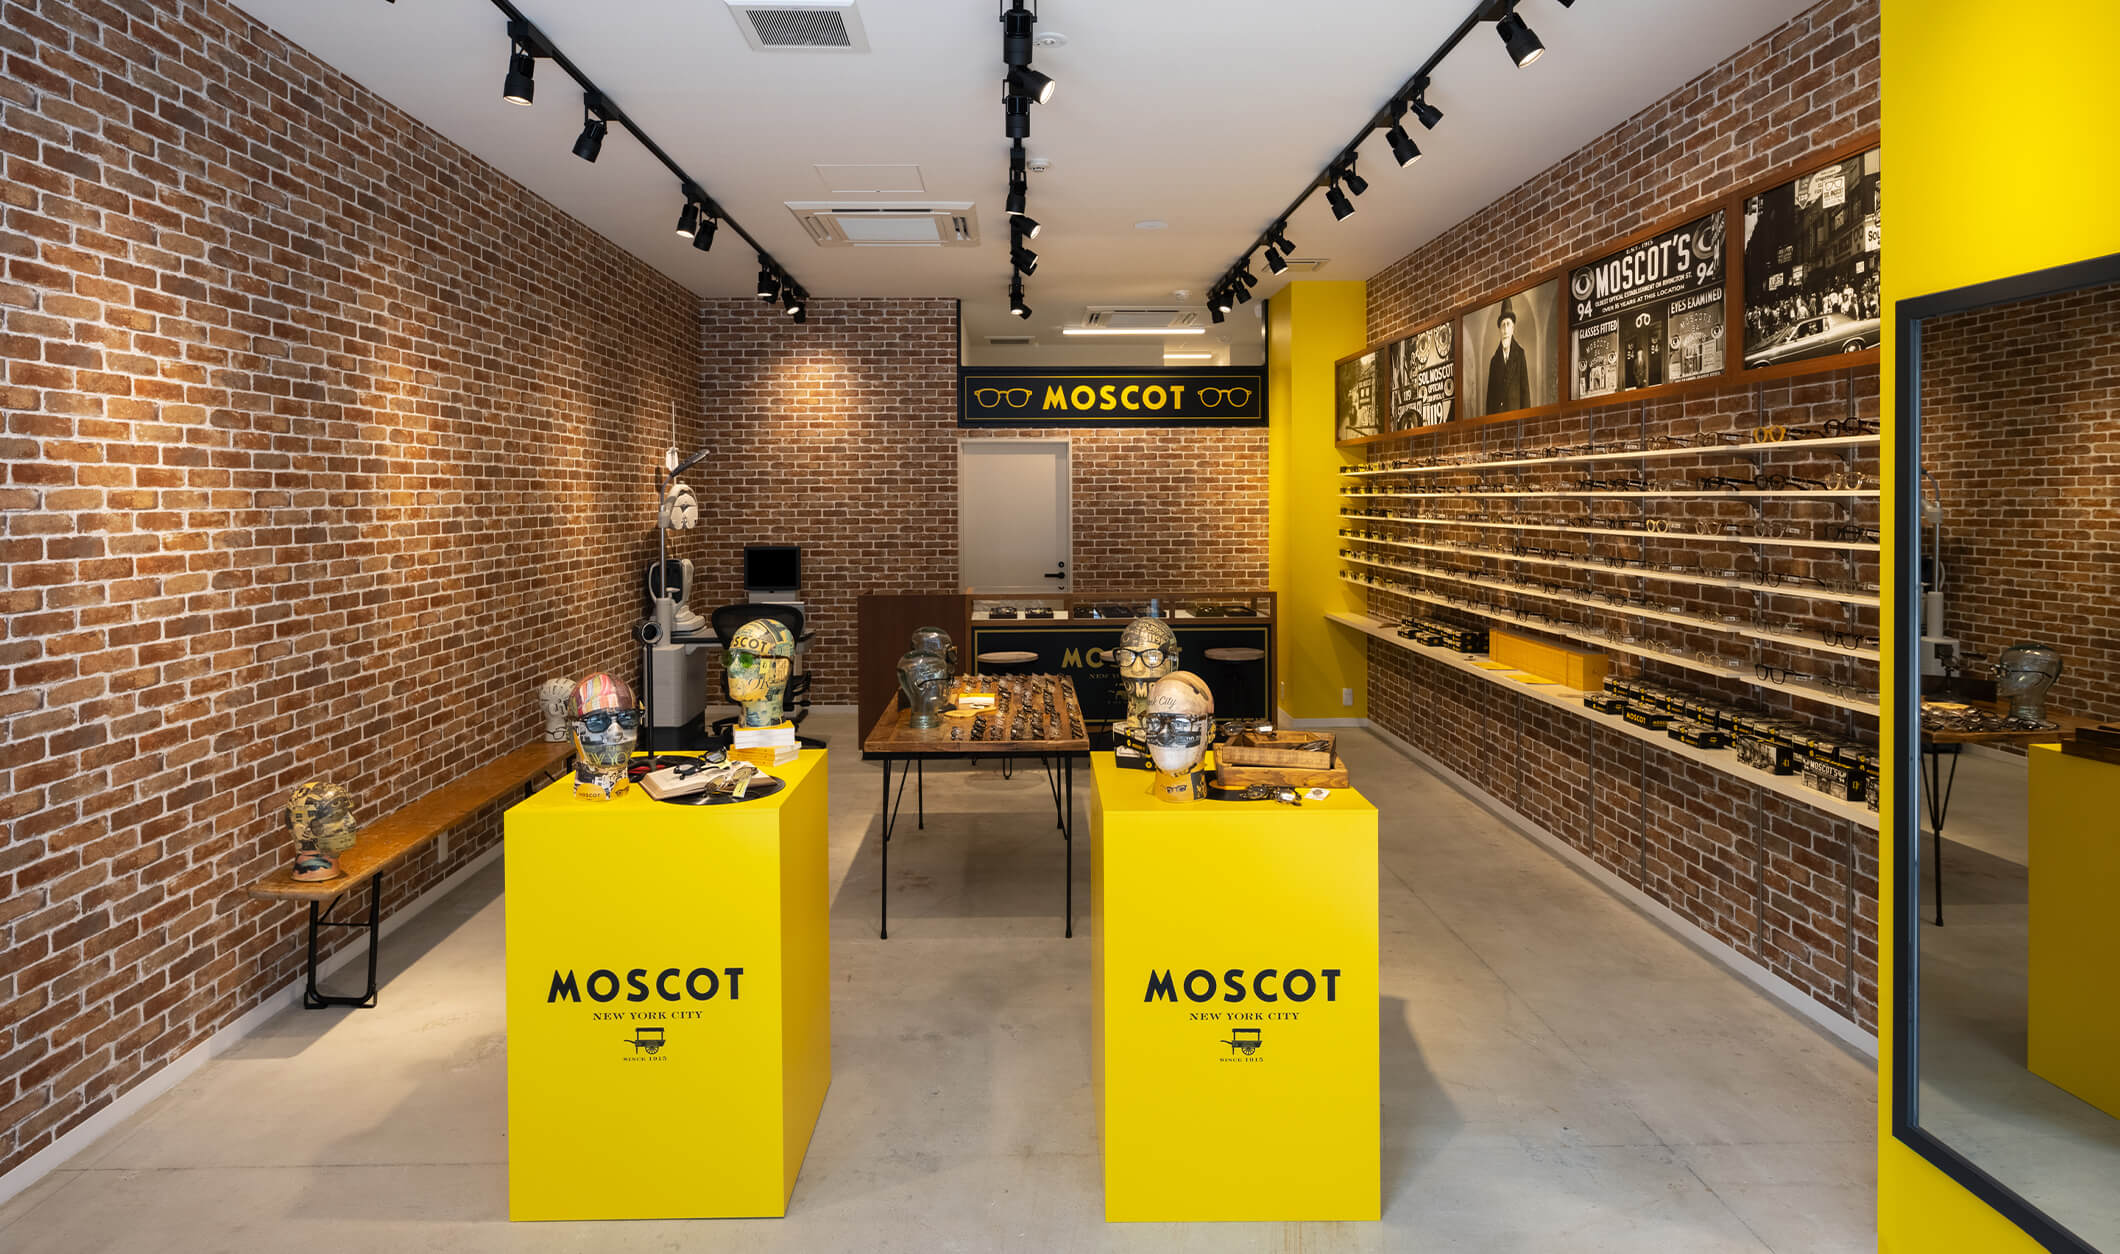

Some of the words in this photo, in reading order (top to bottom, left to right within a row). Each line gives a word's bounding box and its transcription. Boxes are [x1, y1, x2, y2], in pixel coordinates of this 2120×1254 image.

[1595, 233, 1691, 299] MOSCOT'S
[1601, 304, 1614, 313] OVER
[1620, 297, 1637, 307] YEARS
[1644, 292, 1656, 301] THIS
[1656, 283, 1685, 297] LOCATION
[1608, 293, 1624, 304] OPTICAL
[1623, 283, 1655, 299] ESTABLISHMENT
[1670, 296, 1687, 314] EYES
[1687, 287, 1722, 310] EXAMINED
[1577, 300, 1593, 321] 94
[1579, 324, 1600, 340] GLASSES
[1600, 319, 1618, 335] FITTED
[1418, 371, 1430, 386] SOL
[1429, 363, 1454, 383] MOSCOT
[1042, 385, 1184, 410] MOSCOT
[547, 967, 744, 1003] MOSCOT
[1144, 968, 1341, 1003] MOSCOT
[593, 1012, 625, 1021] NEW
[630, 1011, 667, 1020] YORK
[671, 1011, 703, 1020] CITY
[1189, 1012, 1222, 1021] NEW
[1226, 1012, 1264, 1021] YORK
[1268, 1012, 1300, 1020] CITY
